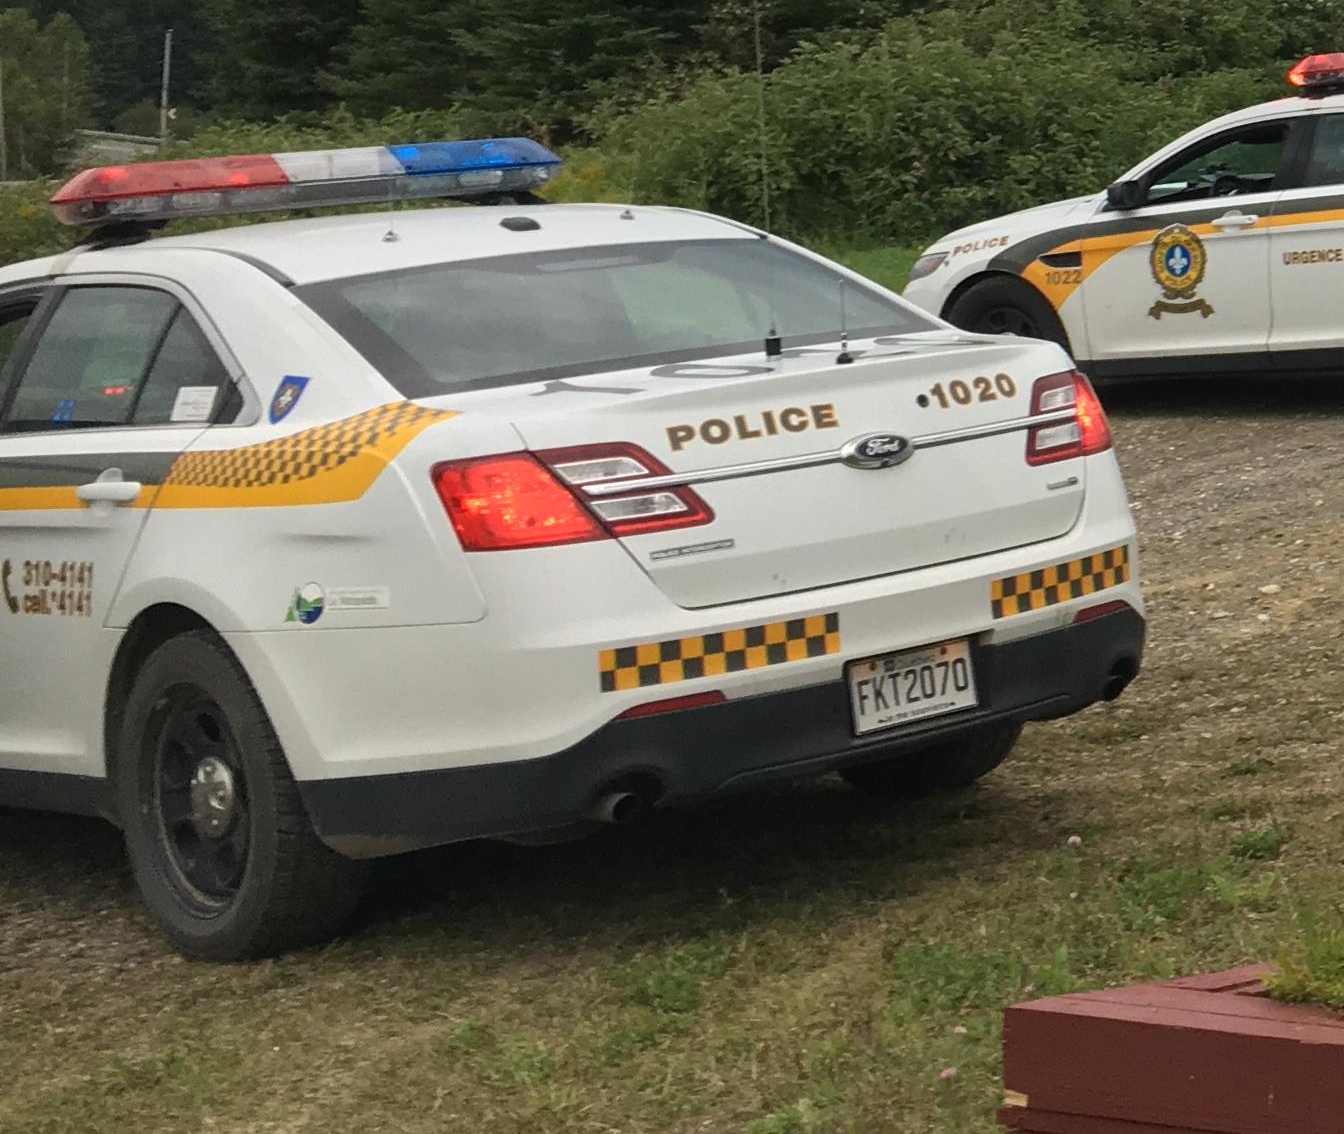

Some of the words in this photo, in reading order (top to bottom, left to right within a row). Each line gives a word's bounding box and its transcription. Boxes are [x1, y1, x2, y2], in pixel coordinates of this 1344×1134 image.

[952, 235, 1010, 257] POLICE
[1282, 248, 1344, 265] URGENCE
[1044, 269, 1082, 286] 1022
[929, 372, 1017, 409] 1020
[665, 402, 841, 453] POLICE
[22, 560, 94, 589] 310-4141
[856, 657, 969, 716] FKT2070
